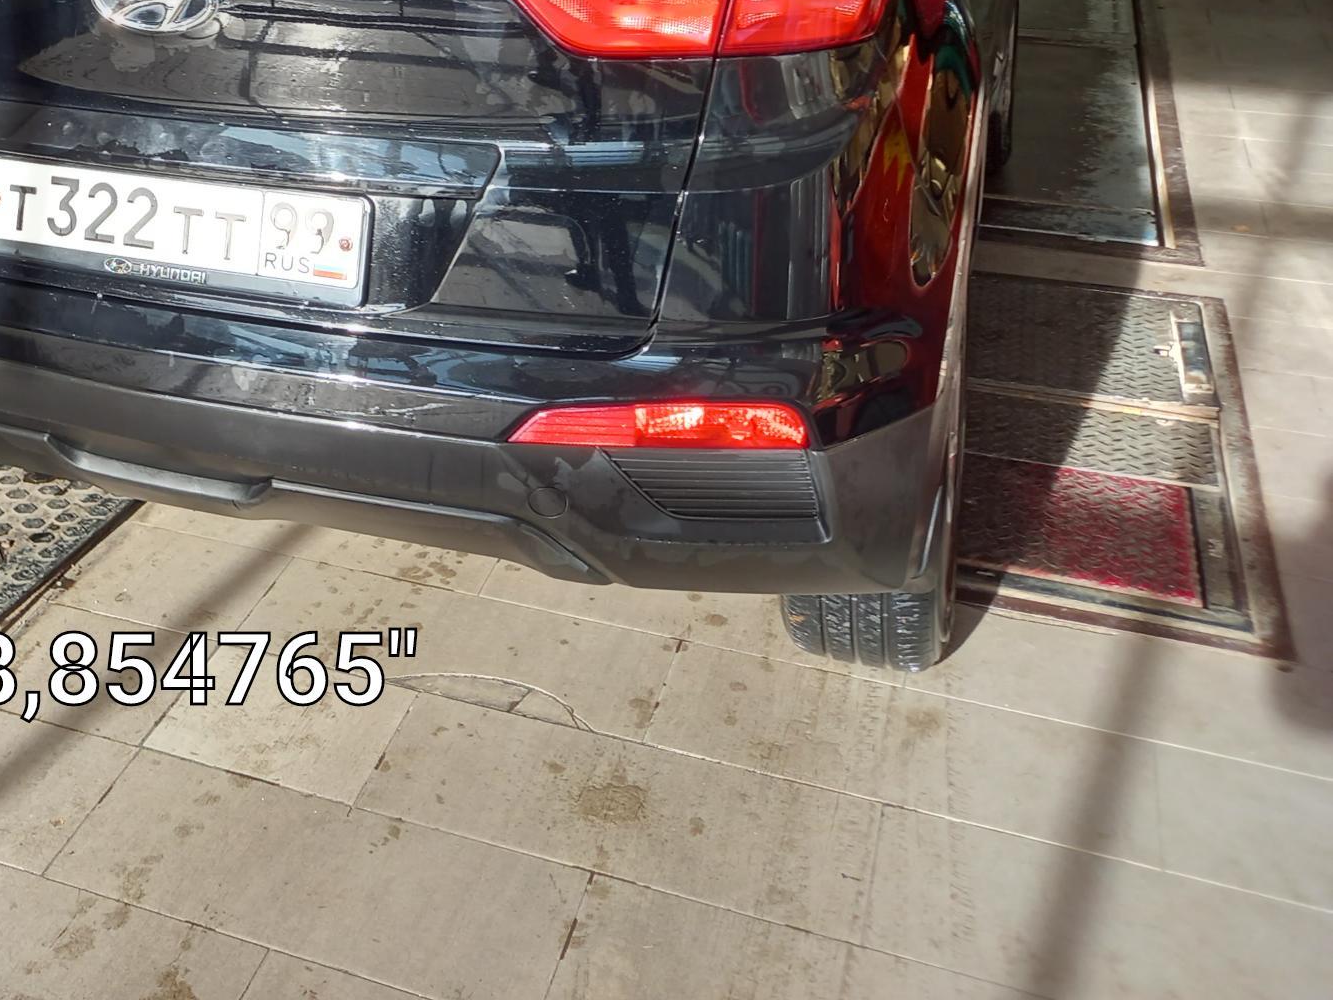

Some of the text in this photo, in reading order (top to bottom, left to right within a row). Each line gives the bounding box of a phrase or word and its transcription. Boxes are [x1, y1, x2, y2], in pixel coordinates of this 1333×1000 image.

[270, 202, 335, 254] 99
[139, 263, 207, 285] HYUNDAI
[264, 252, 310, 274] RUS
